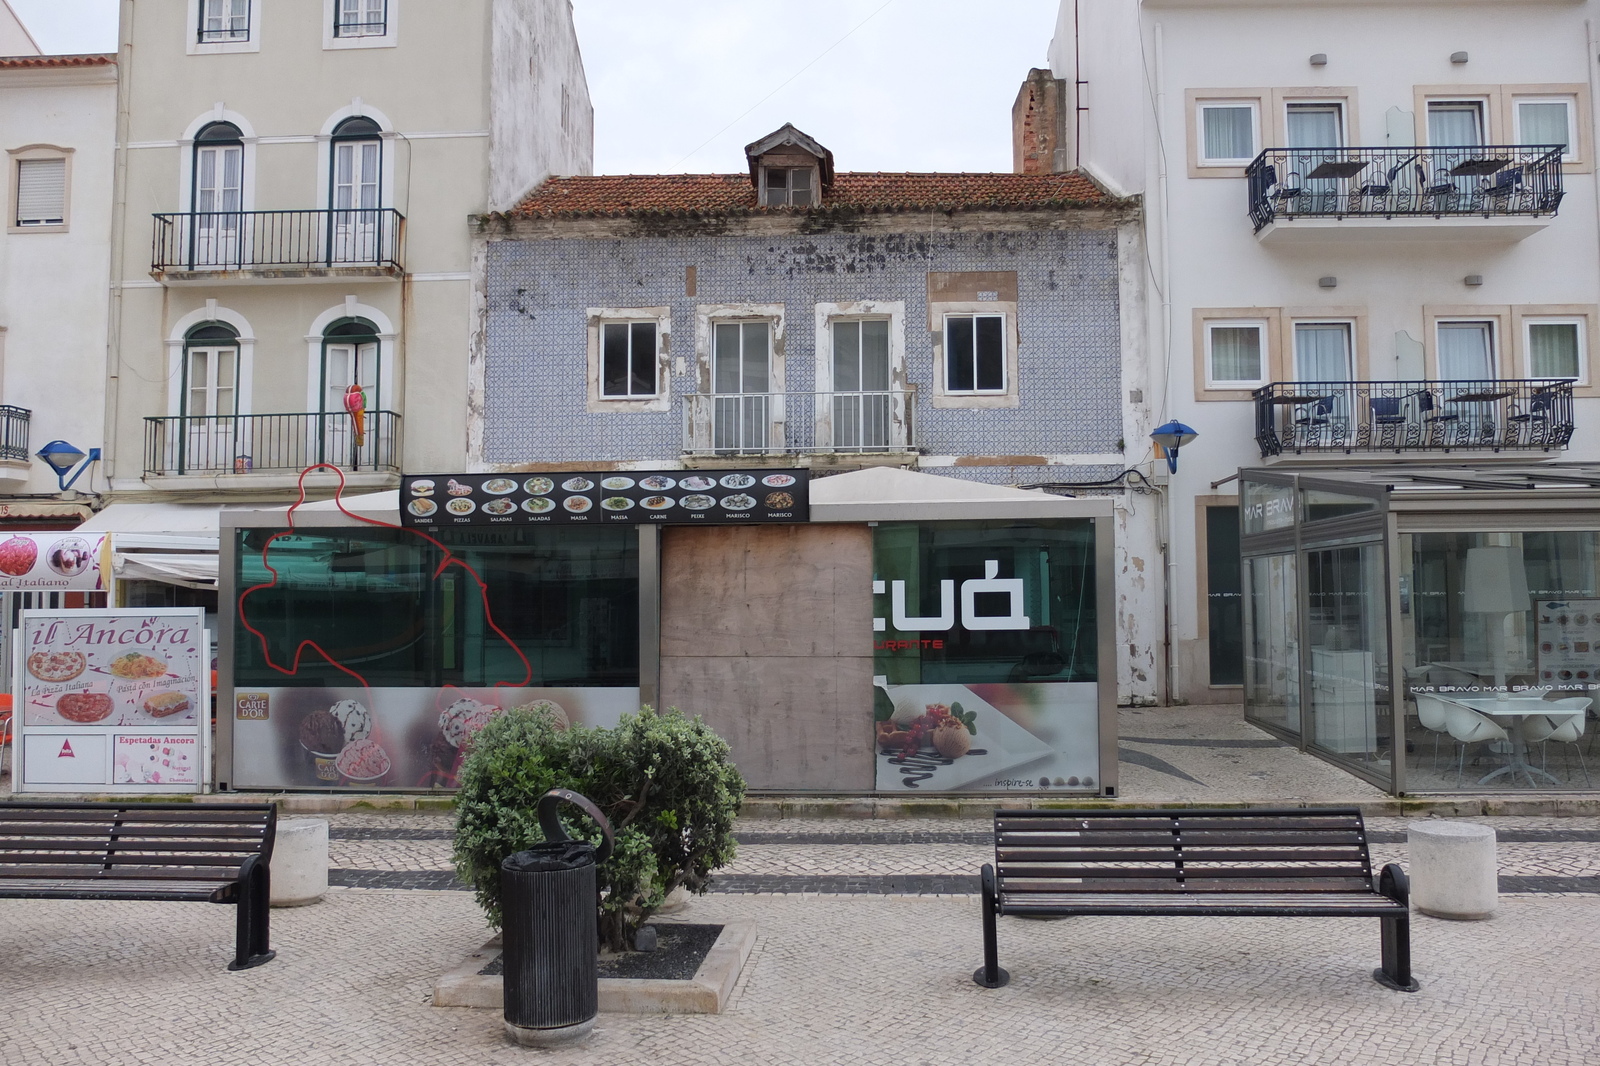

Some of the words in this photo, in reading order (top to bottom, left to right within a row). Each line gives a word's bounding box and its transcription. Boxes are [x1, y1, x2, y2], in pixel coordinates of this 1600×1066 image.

[1244, 503, 1263, 521] MAR
[1266, 496, 1300, 516] BRAV
[18, 577, 70, 588] Italiano
[32, 621, 64, 645] il
[238, 699, 267, 710] CARTE
[119, 736, 161, 745] Espetadas
[163, 736, 195, 744] Ancora
